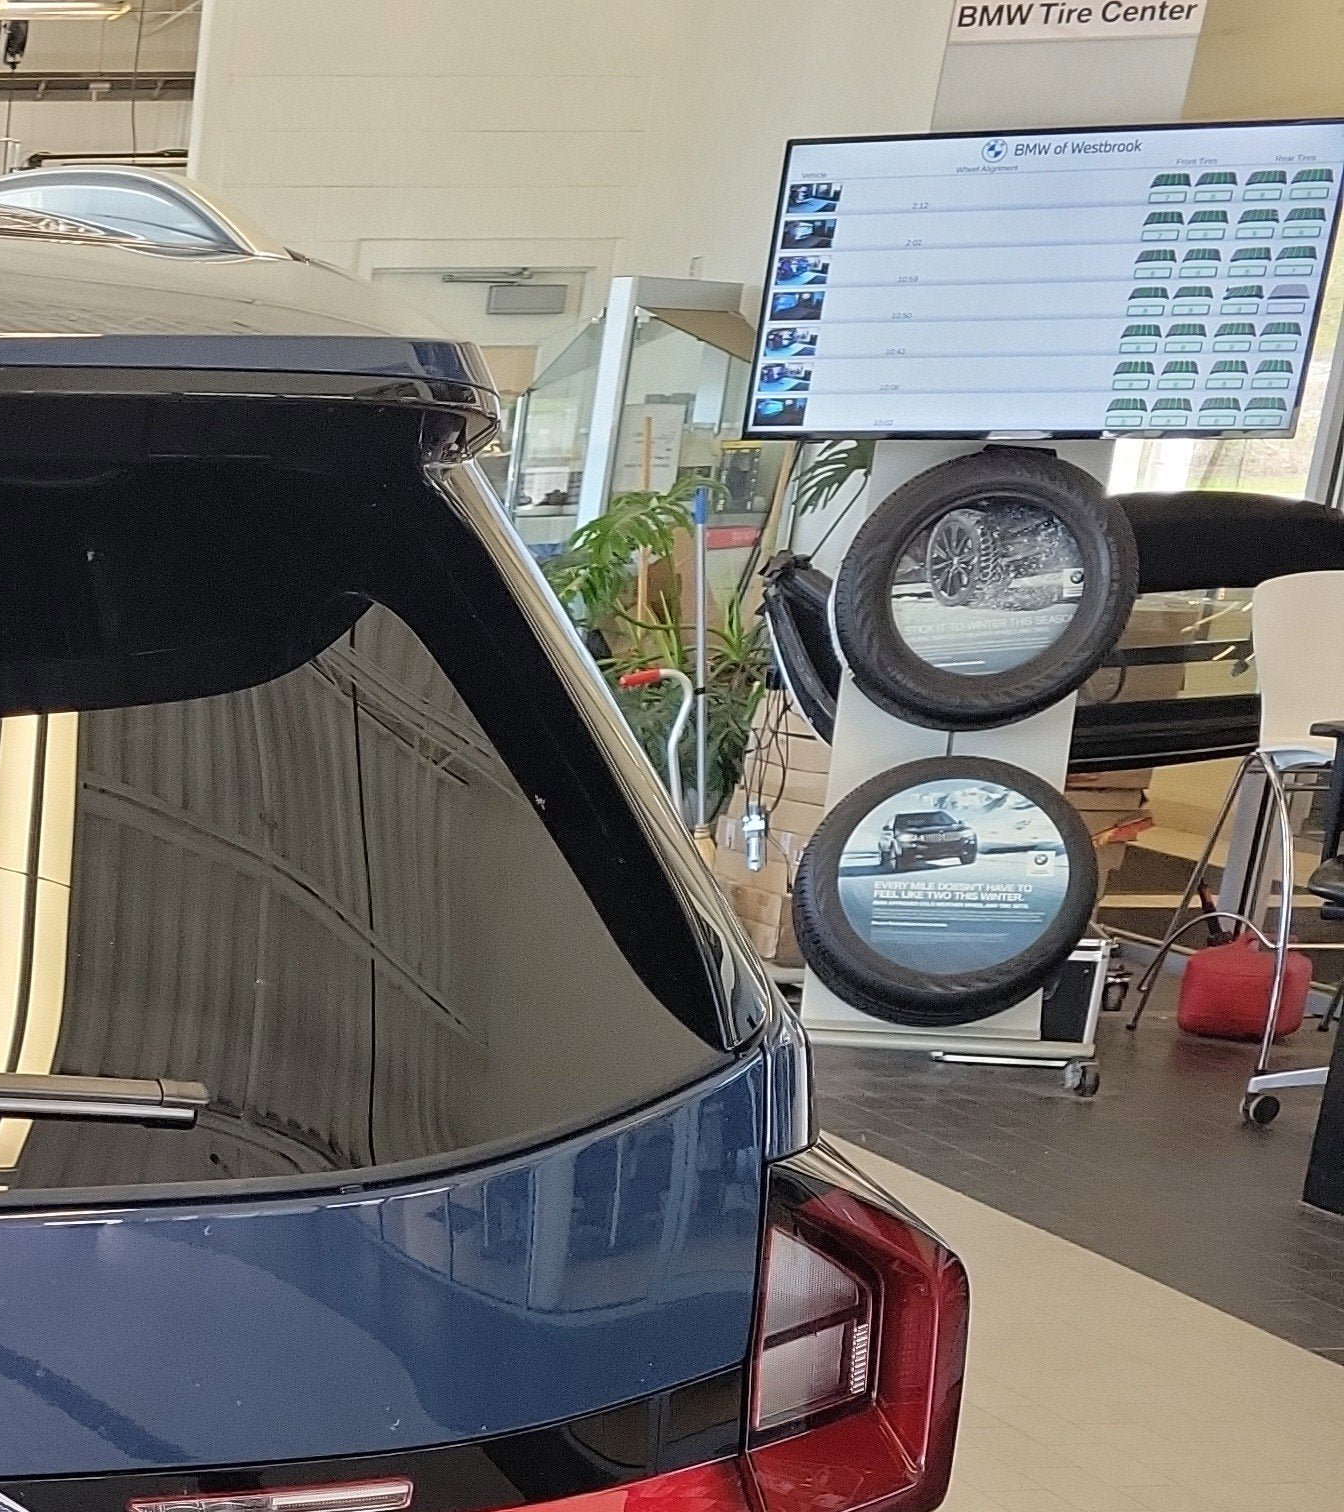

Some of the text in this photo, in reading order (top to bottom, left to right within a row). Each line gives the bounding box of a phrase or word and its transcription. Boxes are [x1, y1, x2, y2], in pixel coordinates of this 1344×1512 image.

[957, 0, 1199, 28] BMW Tire Center
[1014, 138, 1143, 157] BMW of Westbrook
[955, 164, 1019, 174] Wheel Alignment
[1010, 616, 1032, 626] THIS
[874, 881, 1033, 893] EVERY MILE DOESN'T HAVE TO
[873, 889, 1025, 902] FEEL LIKE TWO THIS WINTER.
